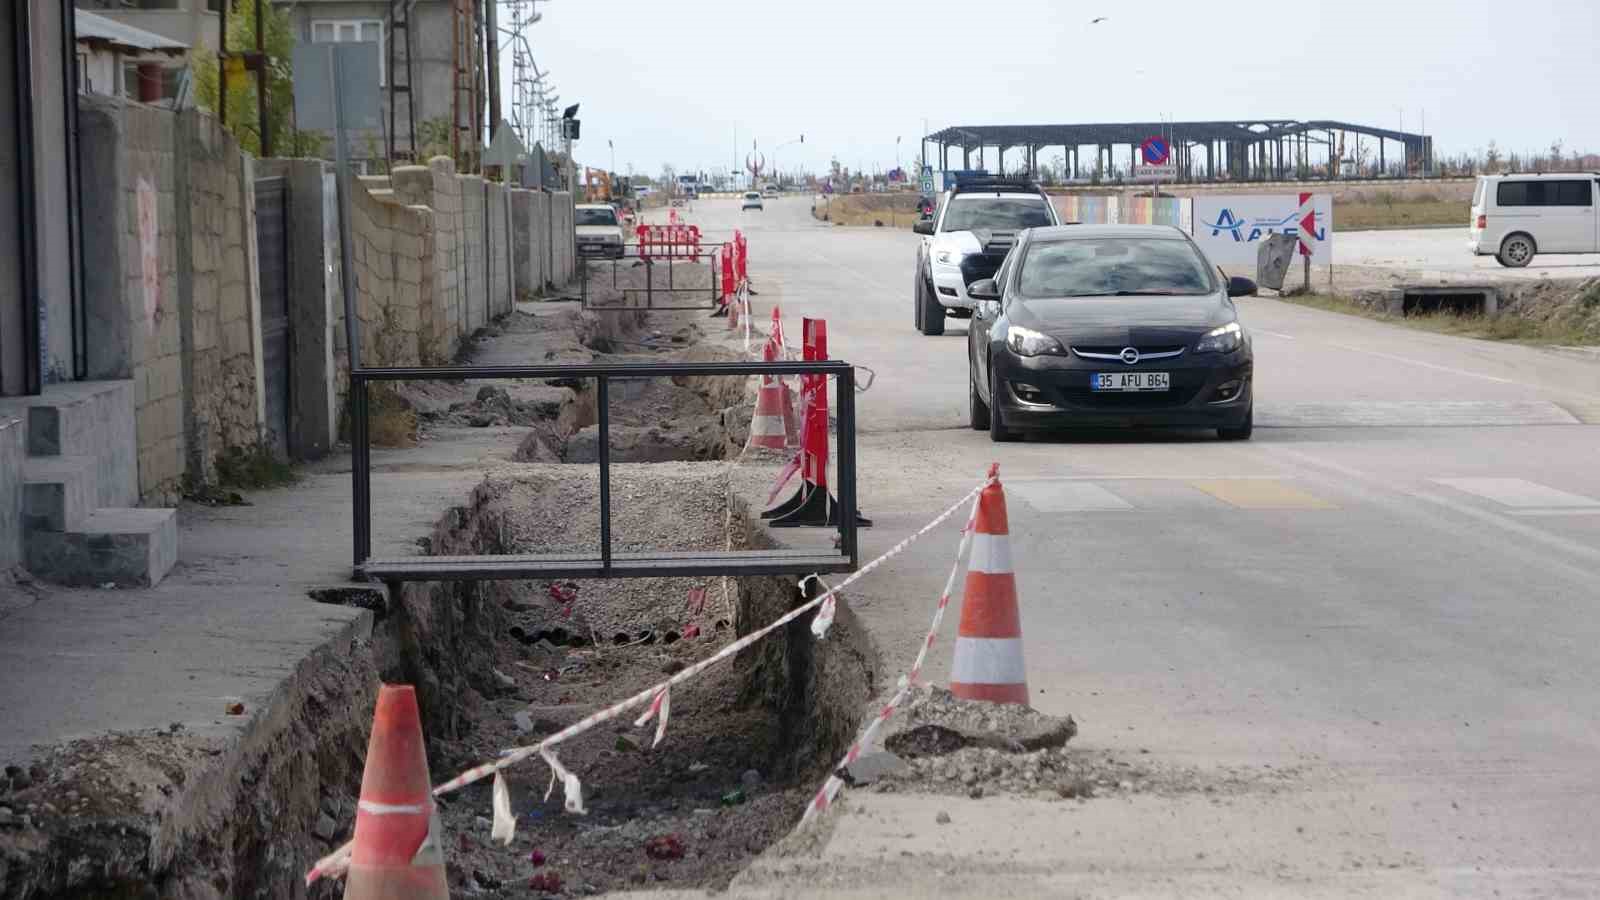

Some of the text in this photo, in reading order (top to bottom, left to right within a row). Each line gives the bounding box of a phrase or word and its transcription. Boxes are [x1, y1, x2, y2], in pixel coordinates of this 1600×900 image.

[1098, 374, 1168, 387] 35 AFU 864
